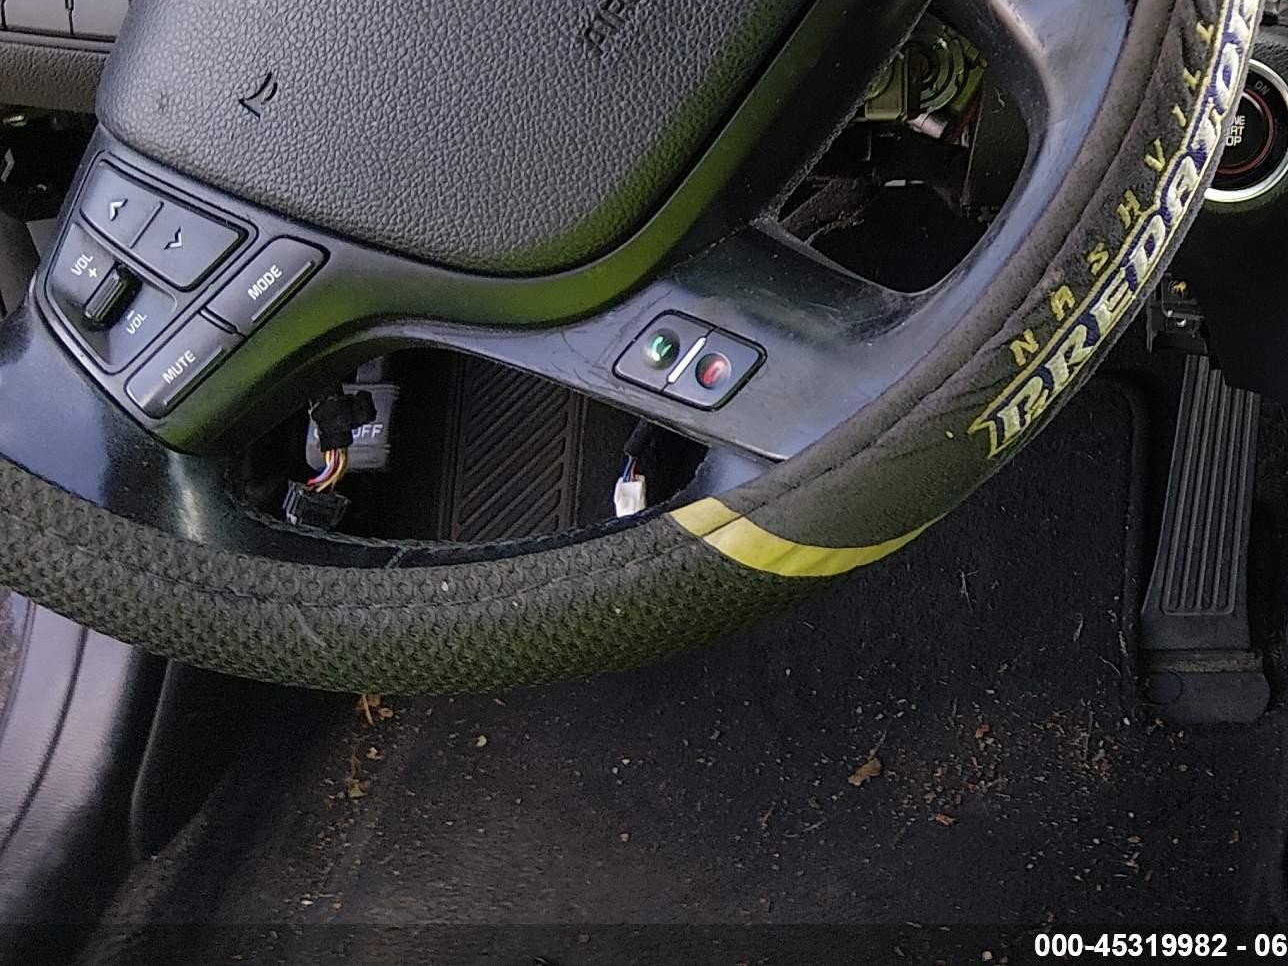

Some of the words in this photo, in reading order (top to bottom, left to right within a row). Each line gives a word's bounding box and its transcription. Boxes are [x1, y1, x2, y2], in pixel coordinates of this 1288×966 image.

[71, 253, 94, 277] VOL
[247, 264, 283, 301] MODE
[127, 314, 148, 335] VOL
[162, 349, 197, 385] MUTE
